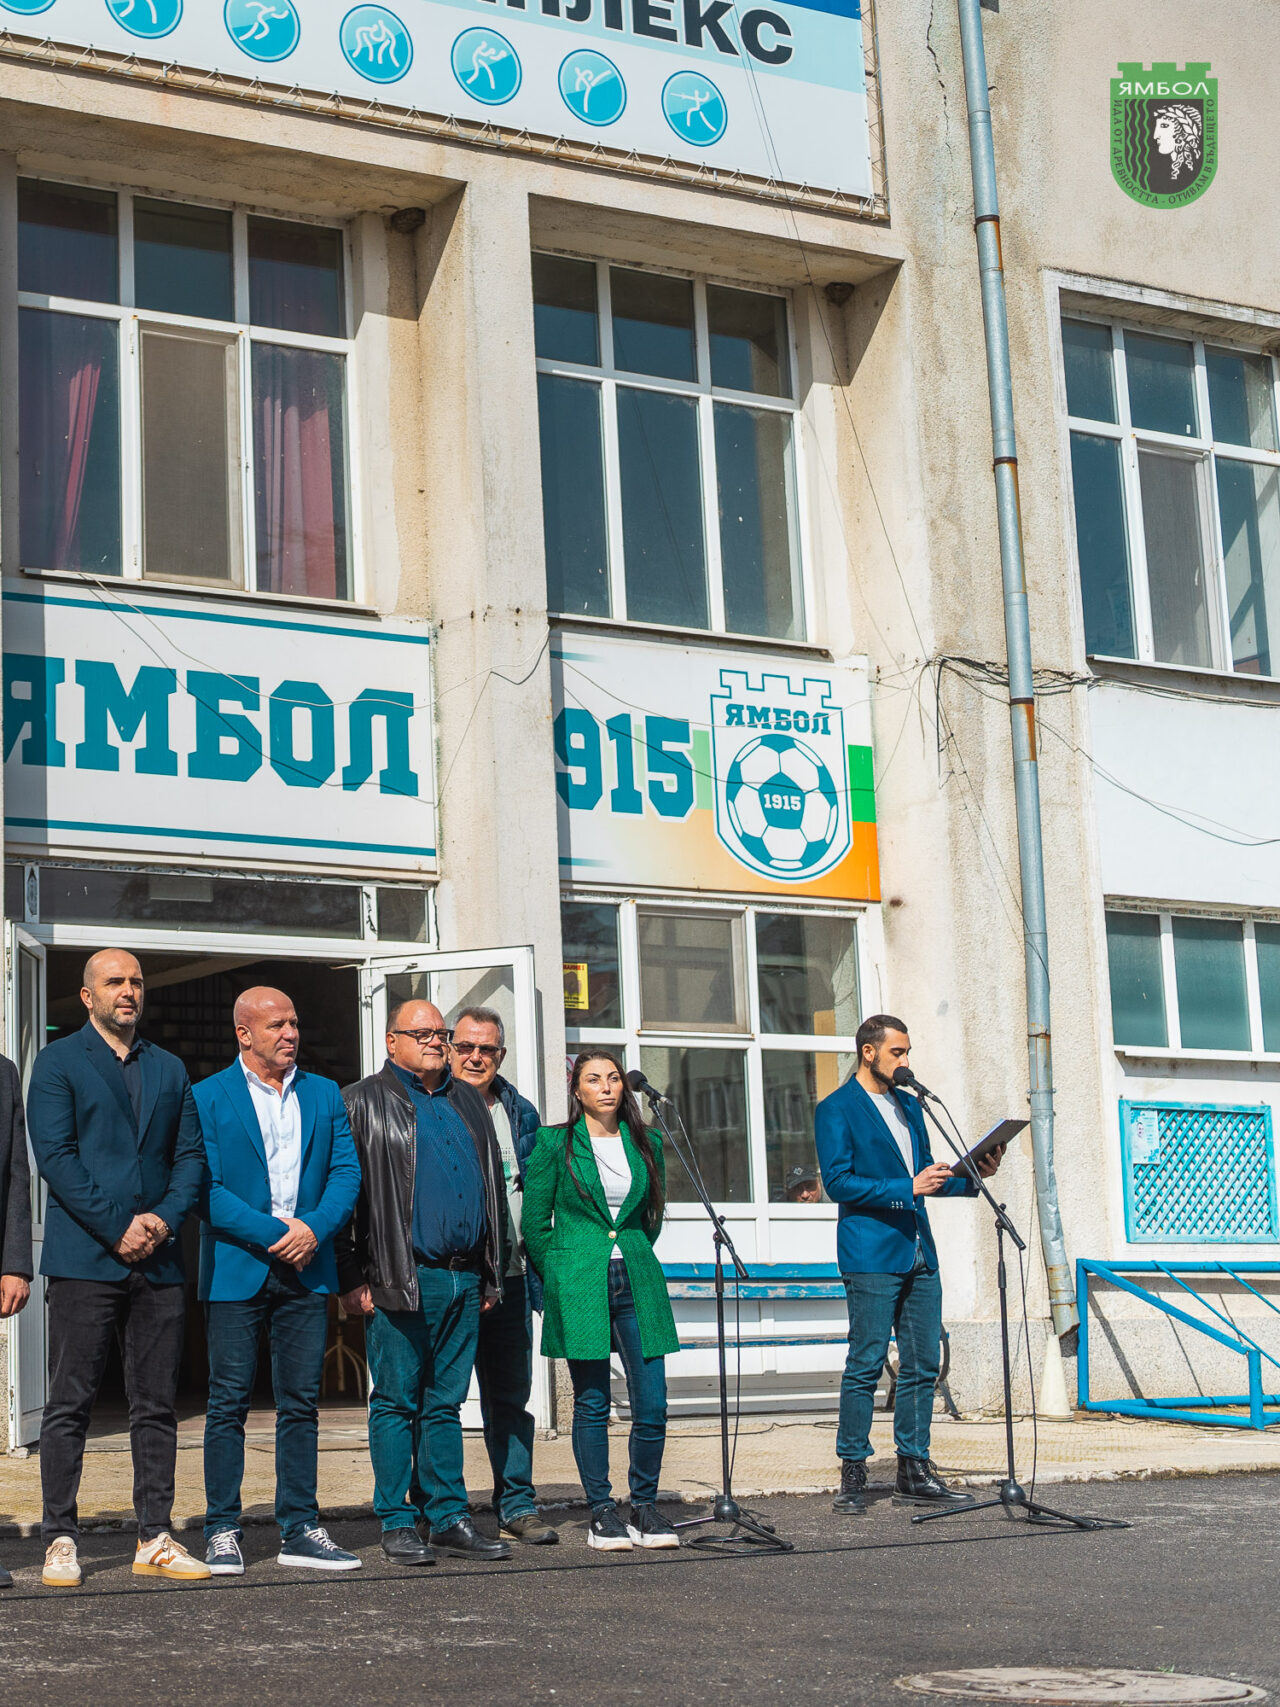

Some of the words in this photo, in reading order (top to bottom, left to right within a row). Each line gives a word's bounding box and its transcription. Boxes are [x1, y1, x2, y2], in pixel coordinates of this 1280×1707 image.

[2, 652, 419, 796] ЯМБОЛ
[725, 703, 831, 735] ЯМБОЛ
[763, 793, 801, 811] 1915
